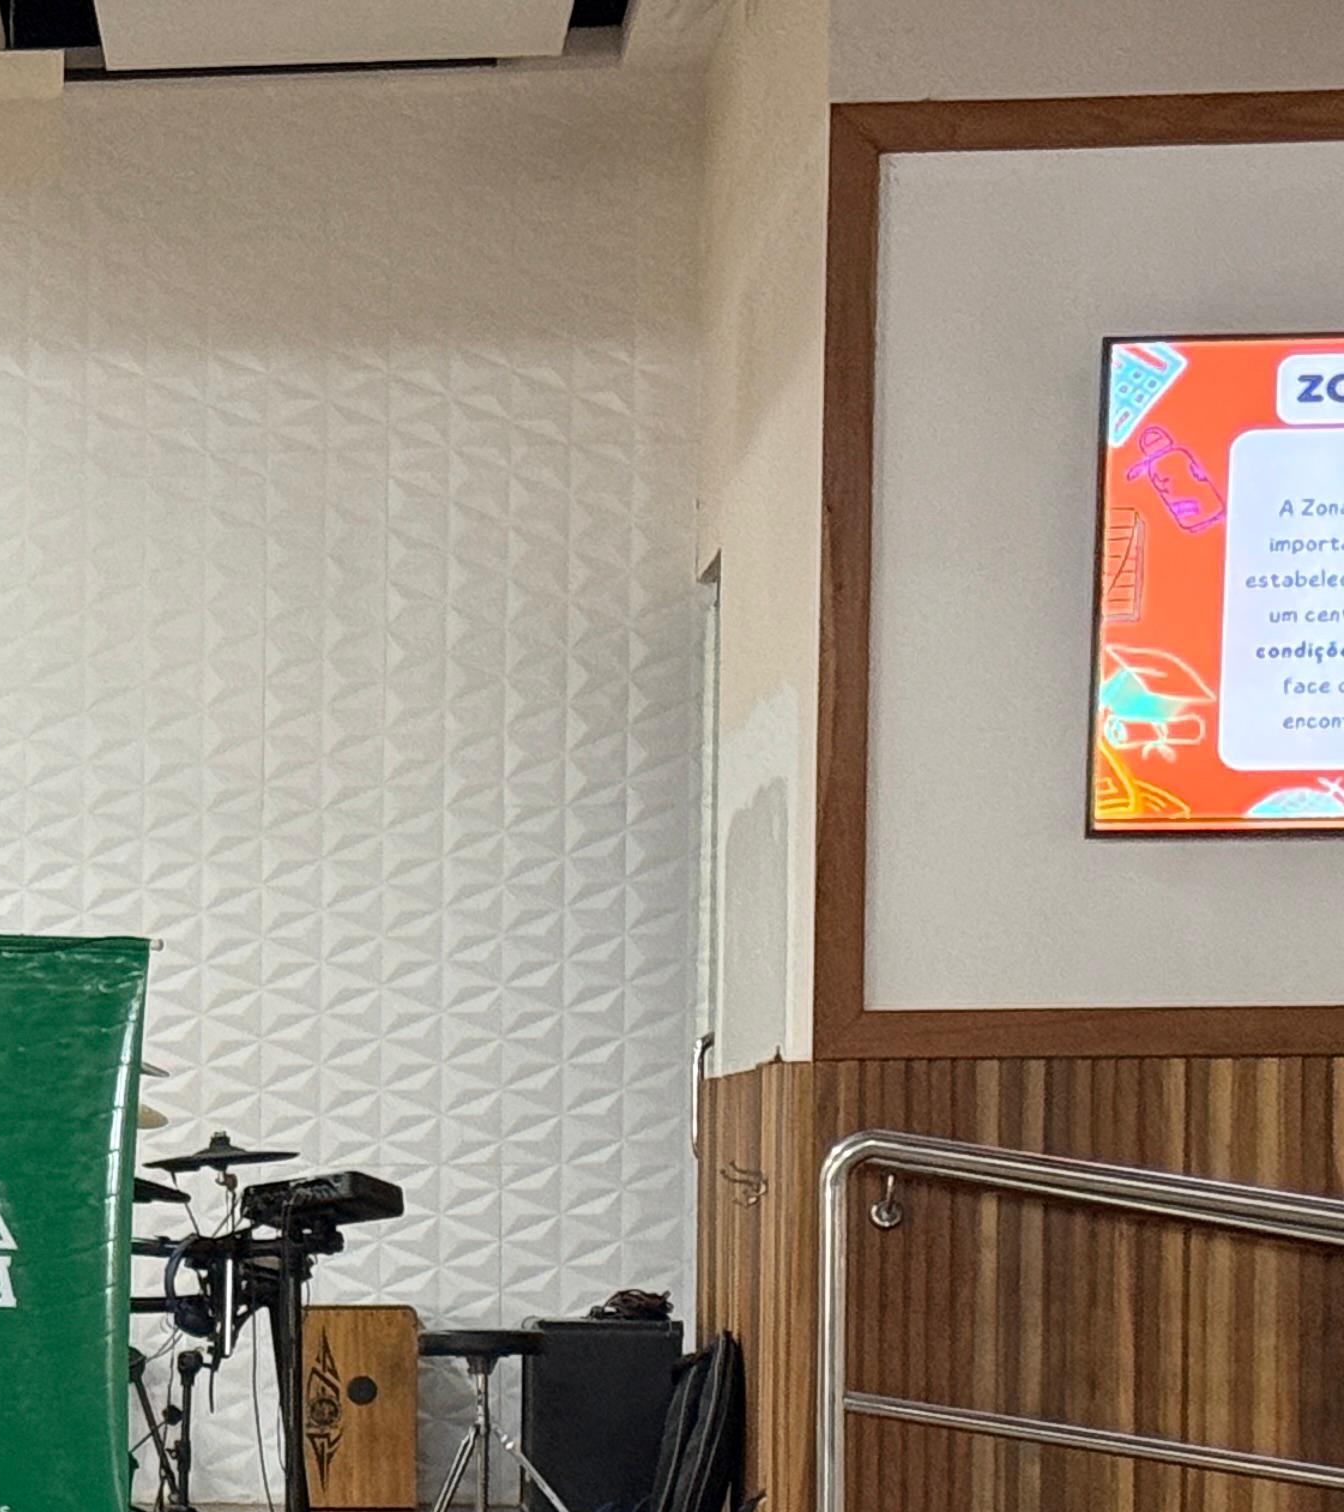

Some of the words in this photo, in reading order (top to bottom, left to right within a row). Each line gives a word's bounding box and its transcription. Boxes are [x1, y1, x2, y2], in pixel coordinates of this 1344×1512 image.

[1279, 499, 1294, 517] A
[1269, 609, 1298, 624] um
[1304, 608, 1344, 623] cen
[1283, 677, 1331, 695] face
[1282, 715, 1344, 730] encon
